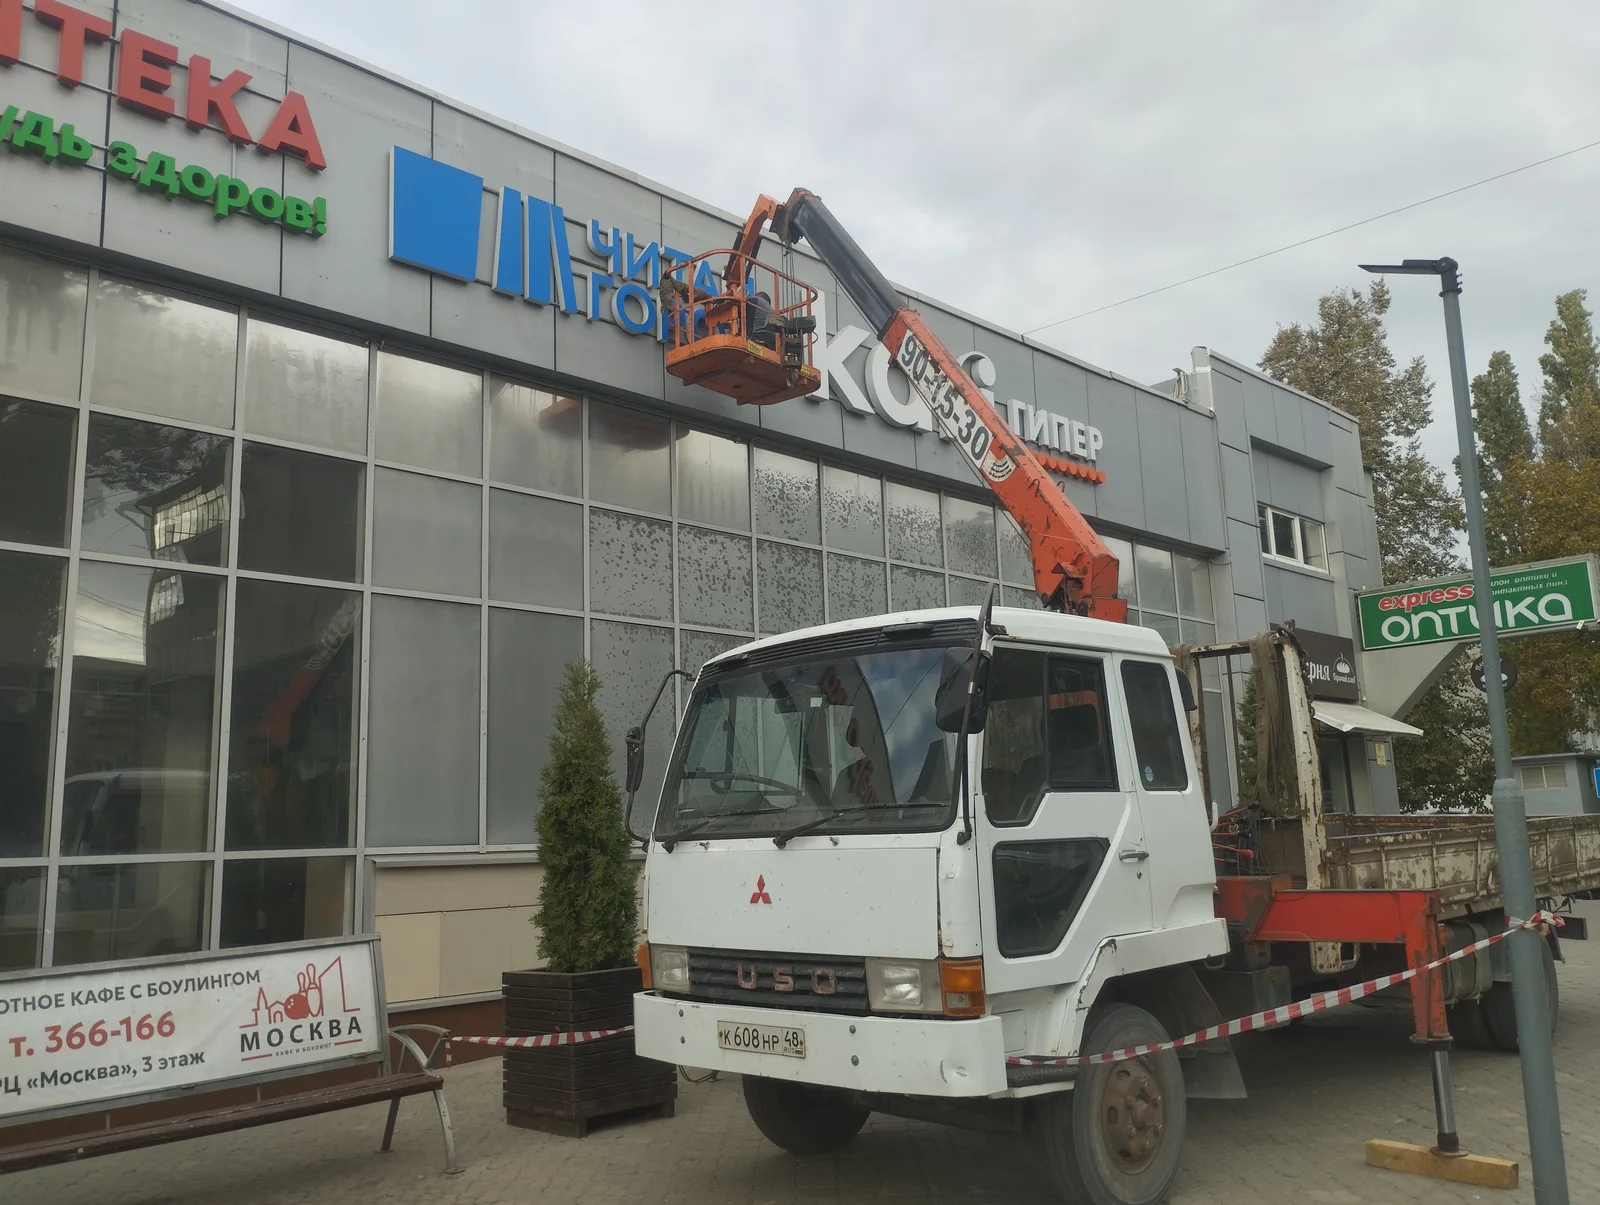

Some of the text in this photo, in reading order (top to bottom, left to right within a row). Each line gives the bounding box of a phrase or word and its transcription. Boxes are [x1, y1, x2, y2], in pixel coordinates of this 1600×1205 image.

[106, 140, 328, 239] здоров!
[587, 218, 755, 297] ЧИТА
[1007, 399, 1103, 462] ГИПЕР
[1378, 584, 1475, 613] express
[1306, 661, 1331, 684] рня
[71, 986, 125, 1007] КАФЕ
[130, 984, 143, 999] С
[147, 969, 261, 998] БОУЛИНГОМ
[737, 963, 838, 995] USO
[9, 1010, 176, 1058] т. 366-166
[240, 1016, 362, 1053] МОСКВА
[275, 1048, 293, 1057] КАФЕ
[302, 1042, 333, 1053] БОУЛИНГ
[783, 1046, 796, 1054] RUS
[784, 1030, 799, 1047] 48
[26, 1061, 138, 1089] «Москва»,
[142, 1055, 153, 1073] 3
[158, 1051, 206, 1070] этаж
